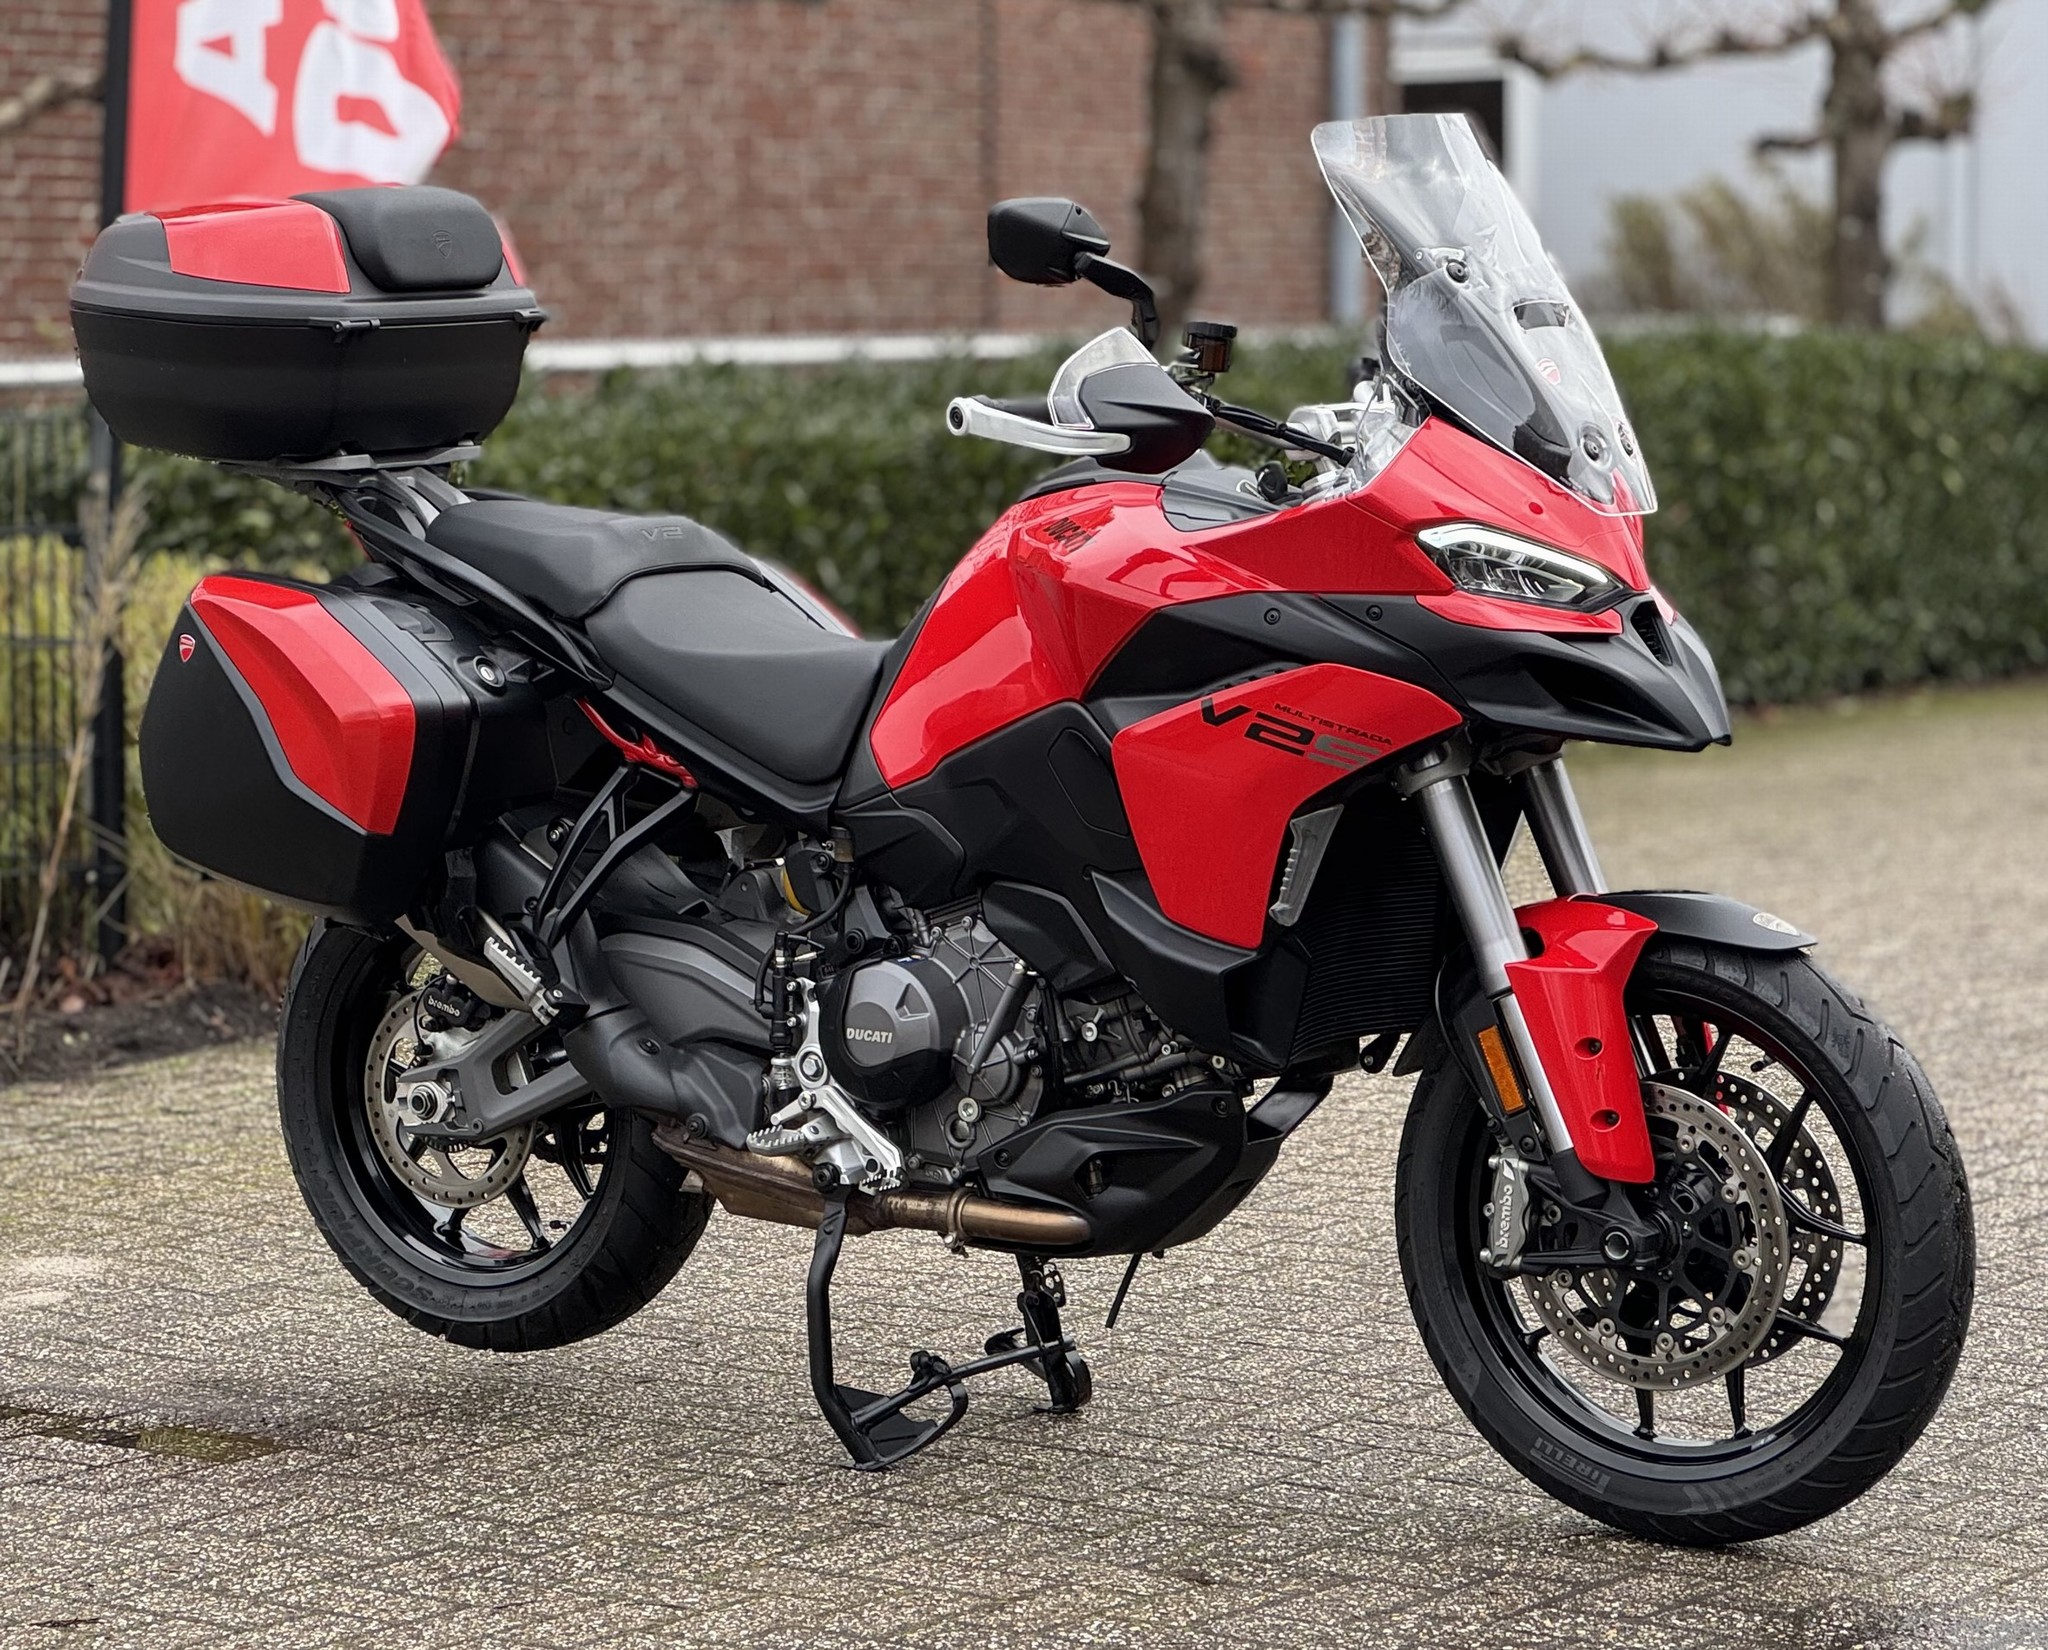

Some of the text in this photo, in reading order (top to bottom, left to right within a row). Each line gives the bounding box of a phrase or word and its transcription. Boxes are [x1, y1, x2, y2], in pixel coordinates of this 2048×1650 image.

[640, 525, 683, 541] V2
[1274, 703, 1393, 746] MULTISTRADA
[428, 995, 460, 1017] brembo
[846, 1027, 893, 1044] DUCATI
[1495, 1184, 1514, 1250] brembo
[1529, 1436, 1612, 1495] PIRELLI
